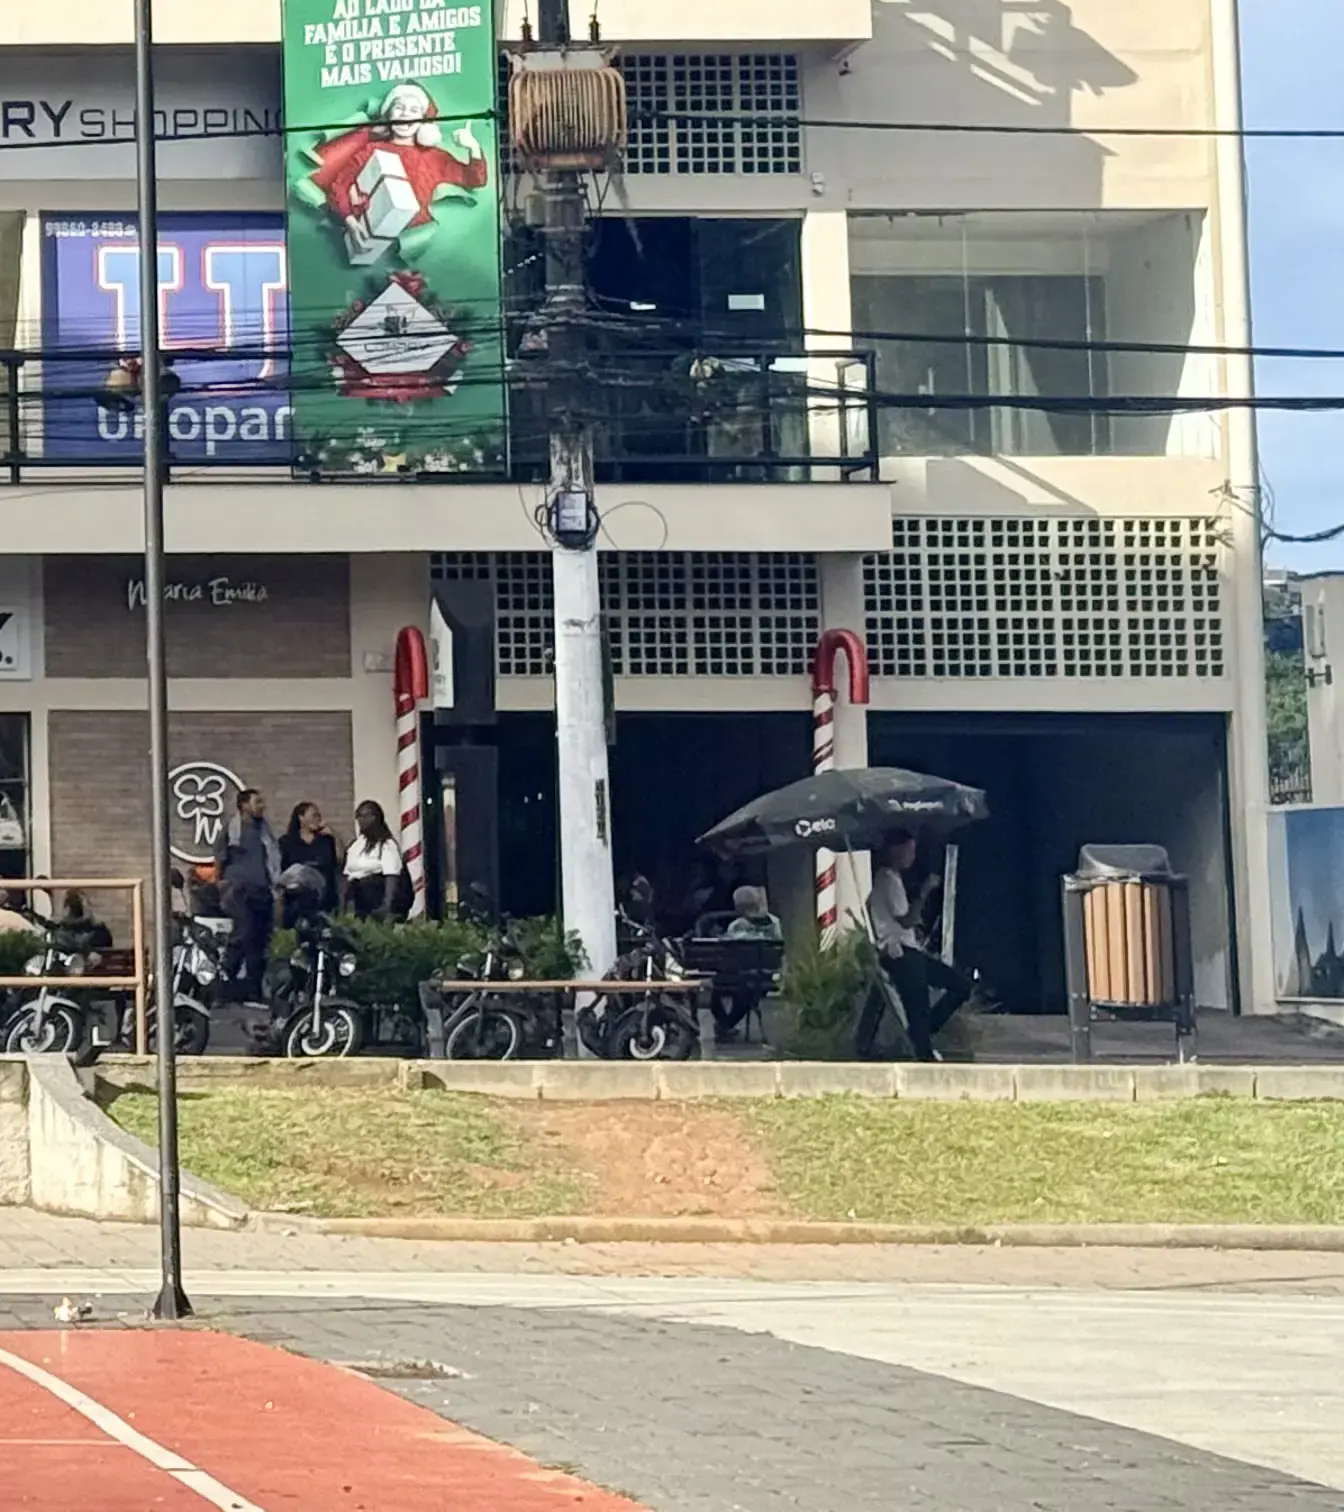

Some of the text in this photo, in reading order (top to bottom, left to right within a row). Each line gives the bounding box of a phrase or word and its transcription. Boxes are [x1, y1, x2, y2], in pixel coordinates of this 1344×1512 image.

[389, 15, 401, 36] E
[406, 6, 481, 33] AMIGOS
[342, 44, 355, 63] O
[359, 31, 456, 62] PRESENTE
[321, 52, 462, 88] MAIS VALIOSO!
[79, 108, 284, 138] SHOPPIN
